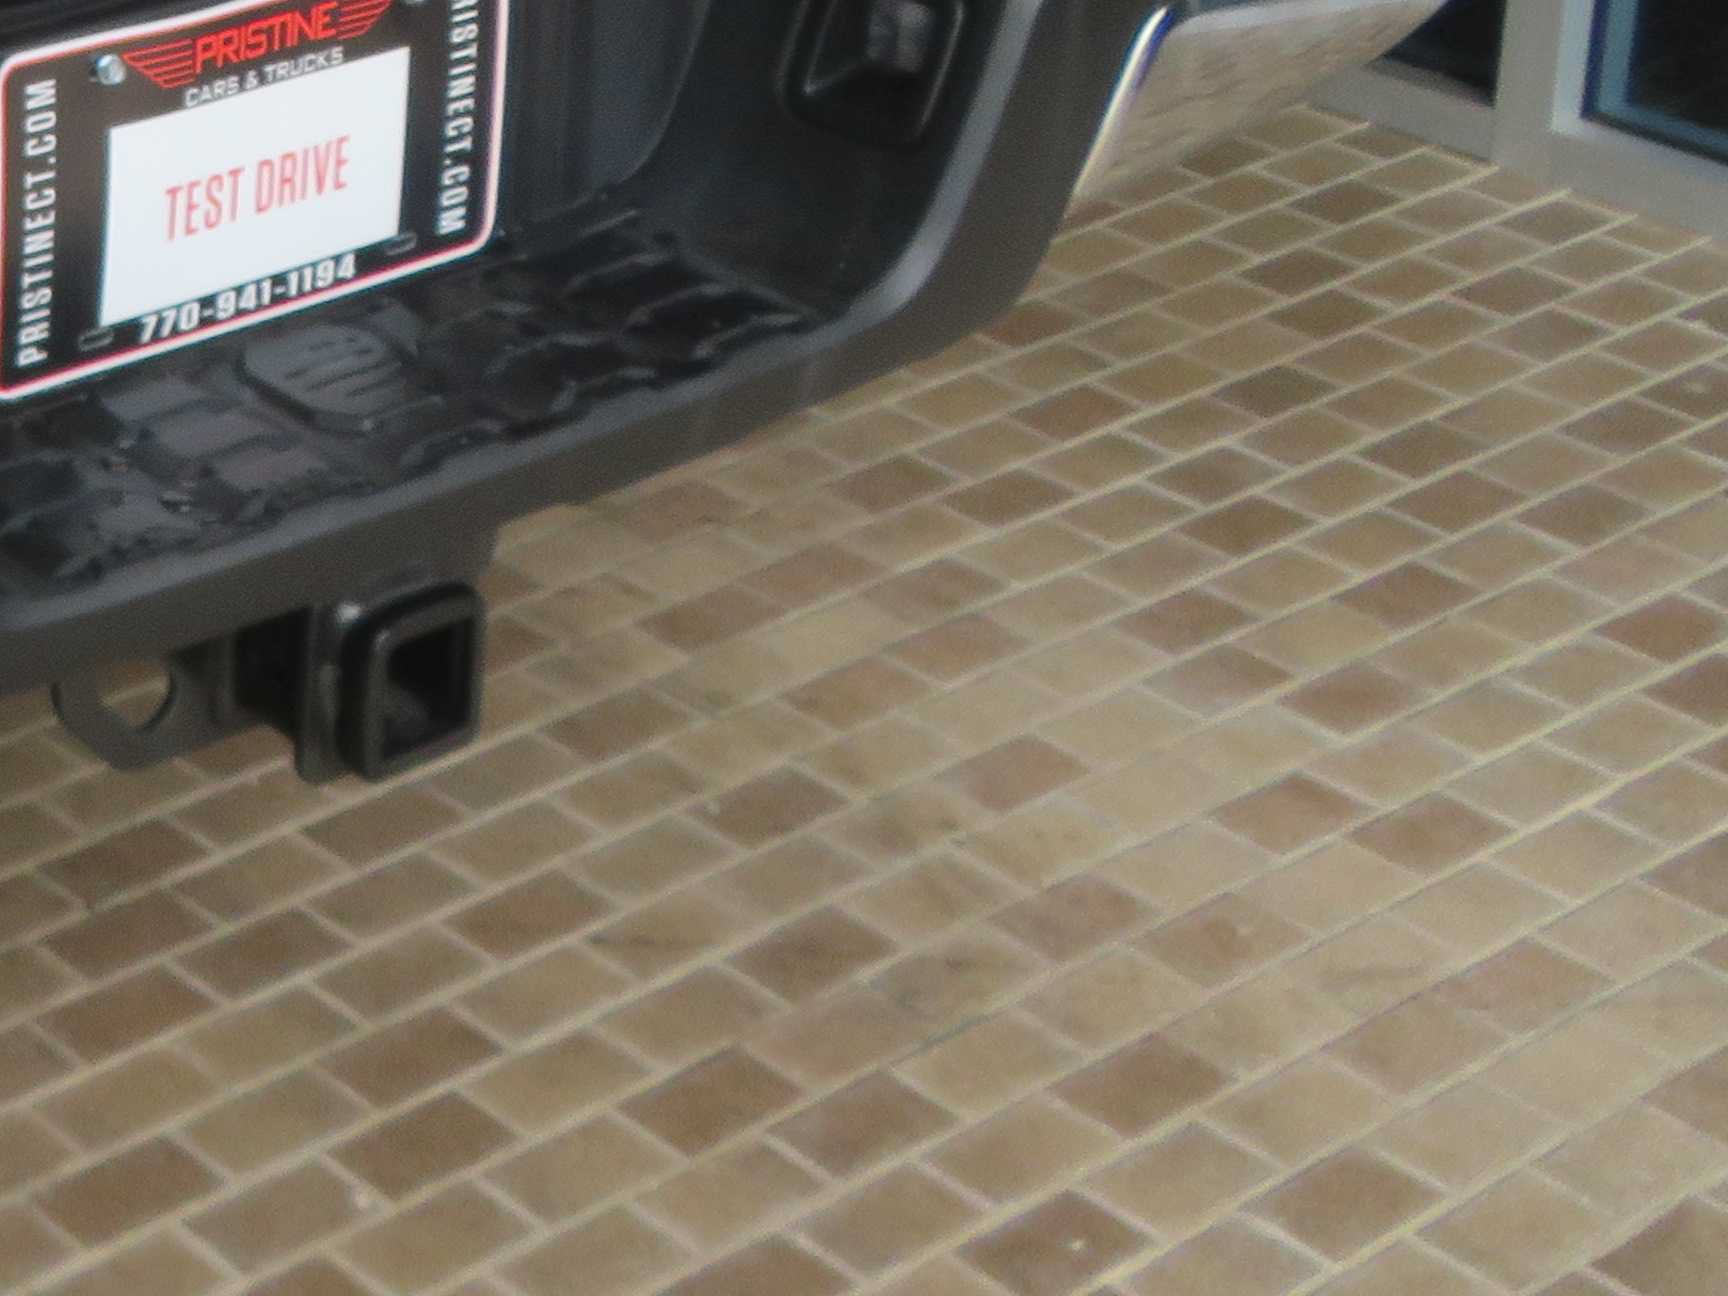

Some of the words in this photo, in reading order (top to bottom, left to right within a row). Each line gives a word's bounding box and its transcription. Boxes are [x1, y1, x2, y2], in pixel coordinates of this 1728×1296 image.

[184, 76, 243, 108] CARS
[244, 71, 260, 91] &
[263, 45, 345, 86] TRUCKS
[194, 0, 339, 75] PRISTINE
[17, 78, 58, 368] PRISTINECT.COM
[165, 166, 245, 242] TEST
[255, 135, 351, 215] DRIVE
[138, 253, 358, 342] 770-941-1194
